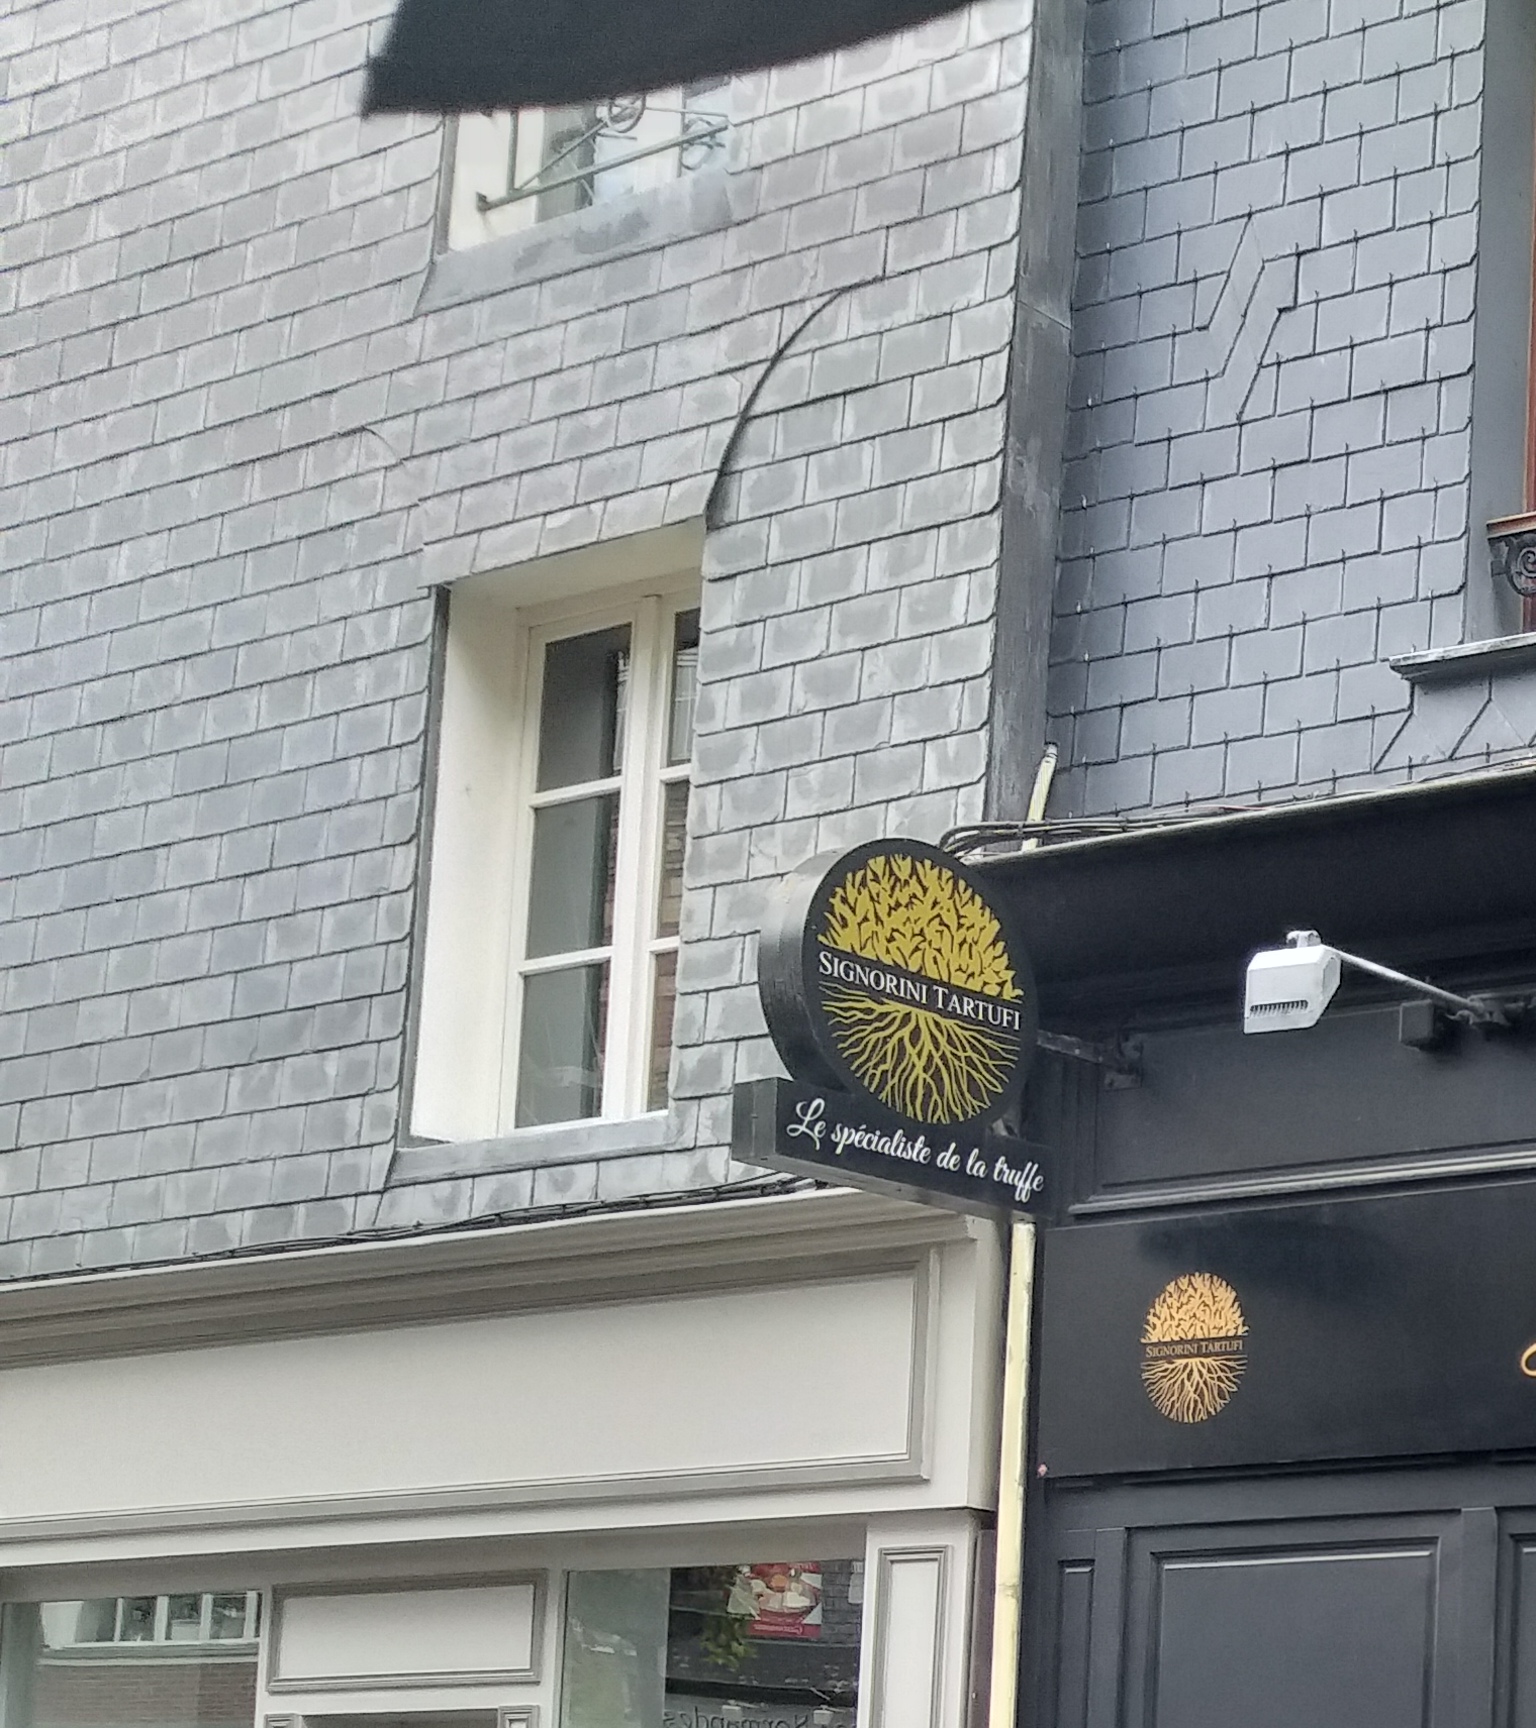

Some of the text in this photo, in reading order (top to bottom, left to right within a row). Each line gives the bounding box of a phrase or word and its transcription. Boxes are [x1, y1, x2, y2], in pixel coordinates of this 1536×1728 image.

[819, 951, 1021, 1031] SIGNORINI TARTUFI
[787, 1098, 1045, 1204] Le spécialiste de la truffe
[1145, 1338, 1243, 1357] SIGNORINI TARTUFI
